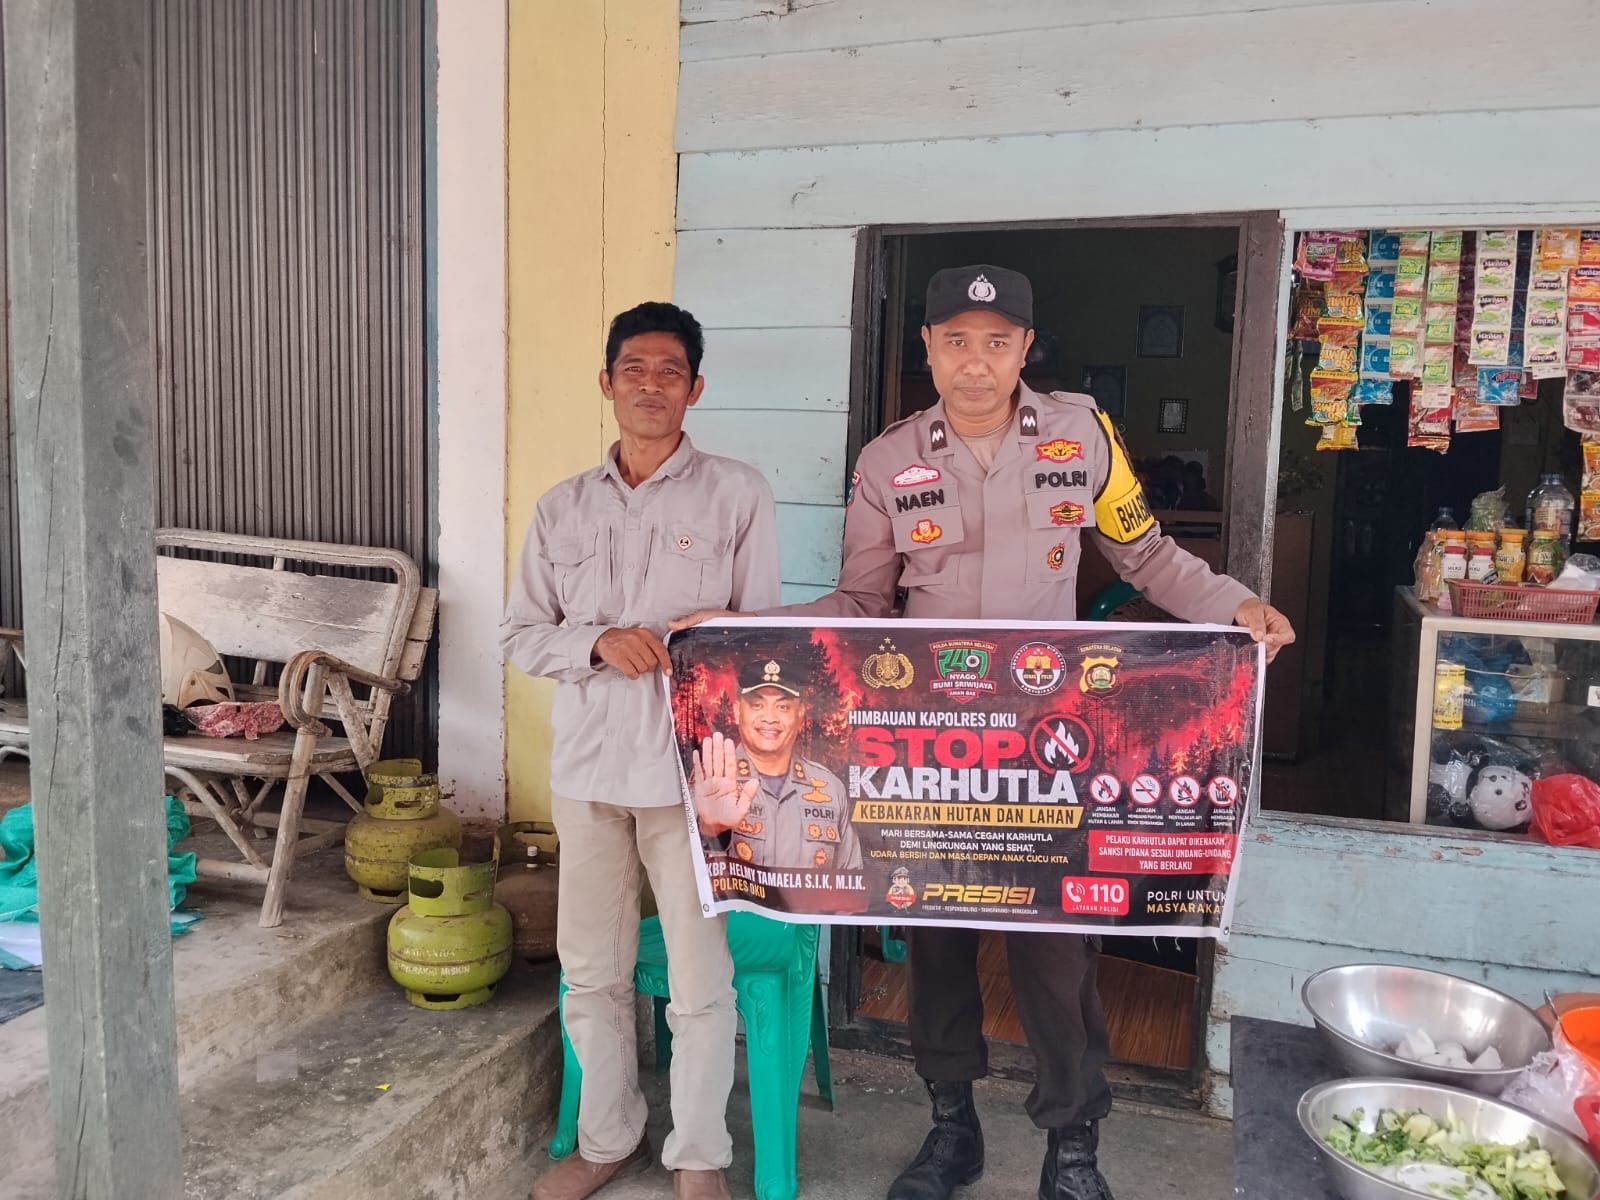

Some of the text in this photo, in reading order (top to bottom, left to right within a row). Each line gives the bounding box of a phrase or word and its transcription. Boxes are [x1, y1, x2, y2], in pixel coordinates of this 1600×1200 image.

[1035, 470, 1087, 488] POLRI
[895, 489, 945, 512] NAEN
[1116, 491, 1151, 533] BHAB
[933, 681, 993, 690] BUMI SRIWIJAYA
[848, 711, 1017, 728] HIMBAUAN KAPOLRES OKU
[855, 728, 1026, 770] STOP
[849, 766, 1078, 803] KARHUTLA
[804, 808, 834, 820] POLRI
[860, 804, 1074, 825] KEBAKARAN HUTAN DAN LAHAN
[881, 829, 1053, 842] MARI BERSAMA-SAMA CEGAH KARHUTLA
[1105, 835, 1225, 846] PELAKU KARHUTLA DAPAT DIKENAKAN
[900, 840, 1036, 853] DEMI LINGKUNGAN YANG SEHAT,
[1099, 847, 1123, 857] SANKSI
[1124, 847, 1149, 857] PIDANA
[1151, 848, 1174, 858] SESUAI
[870, 851, 1069, 864] UDARA BERSIH DAN MASA DEPAN ANAK CUCU KITA
[1139, 860, 1193, 870] YANG BERLAKU
[707, 862, 726, 877] KBP
[756, 871, 802, 889] TAMAELA
[713, 877, 749, 891] POLRES
[922, 883, 1036, 905] PRESISI
[1089, 884, 1125, 903] 110
[1147, 890, 1226, 902] POLRI UNTUK
